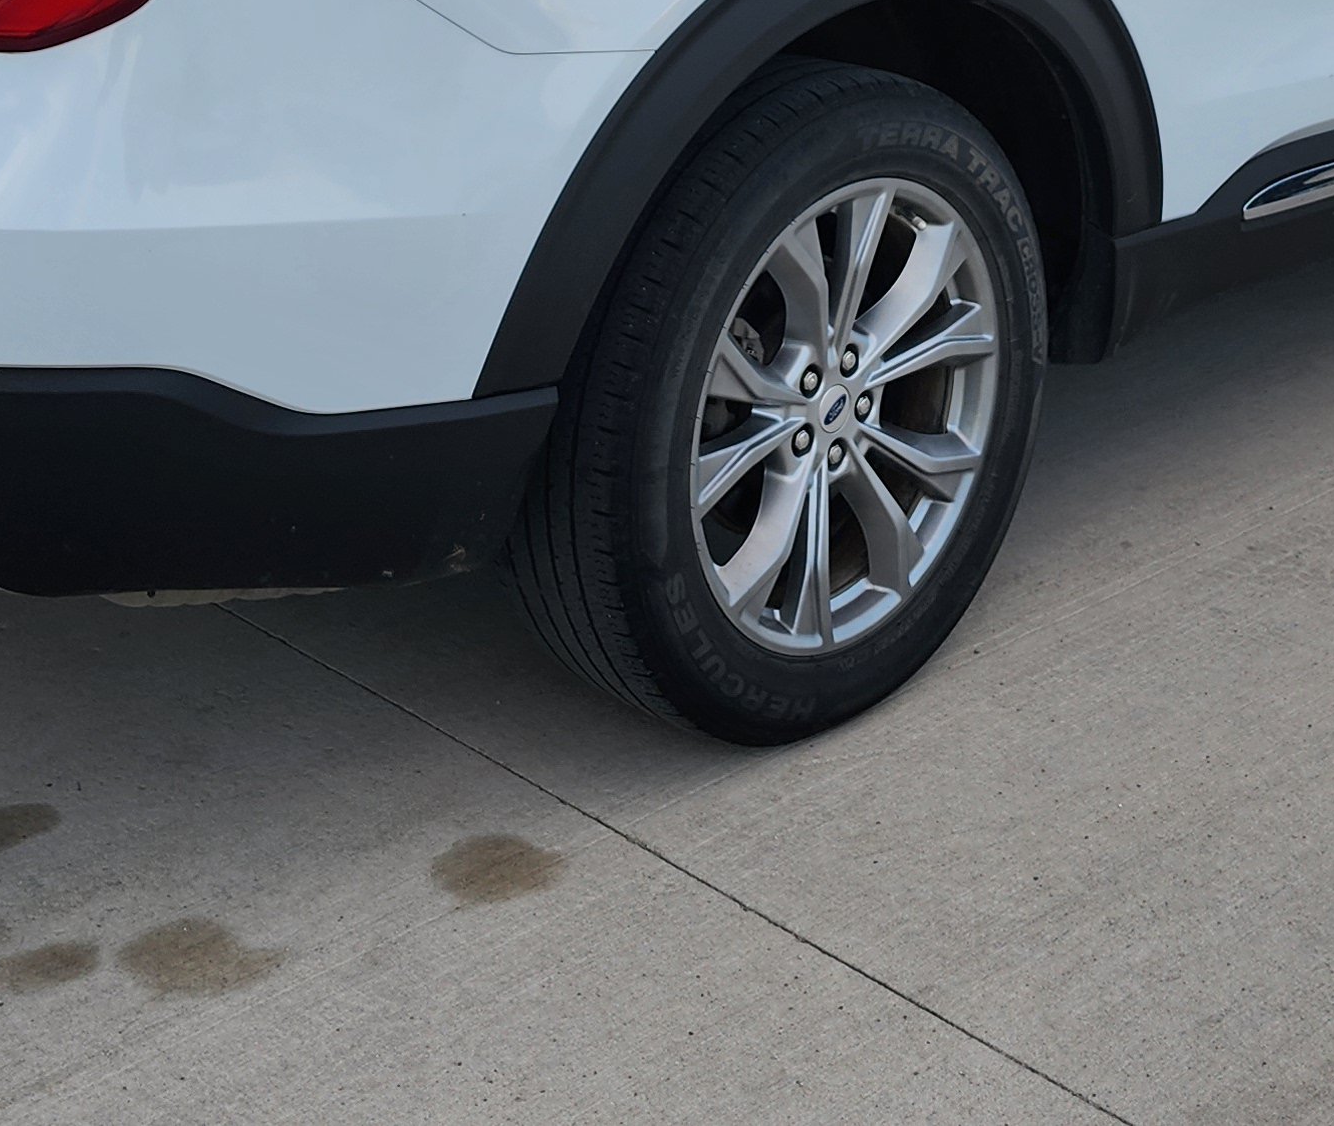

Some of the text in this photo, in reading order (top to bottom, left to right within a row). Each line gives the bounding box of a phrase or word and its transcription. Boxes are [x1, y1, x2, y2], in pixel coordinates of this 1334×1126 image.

[858, 121, 961, 162] TERRA
[965, 146, 1024, 234] TRAC
[665, 572, 818, 721] HERCULES
